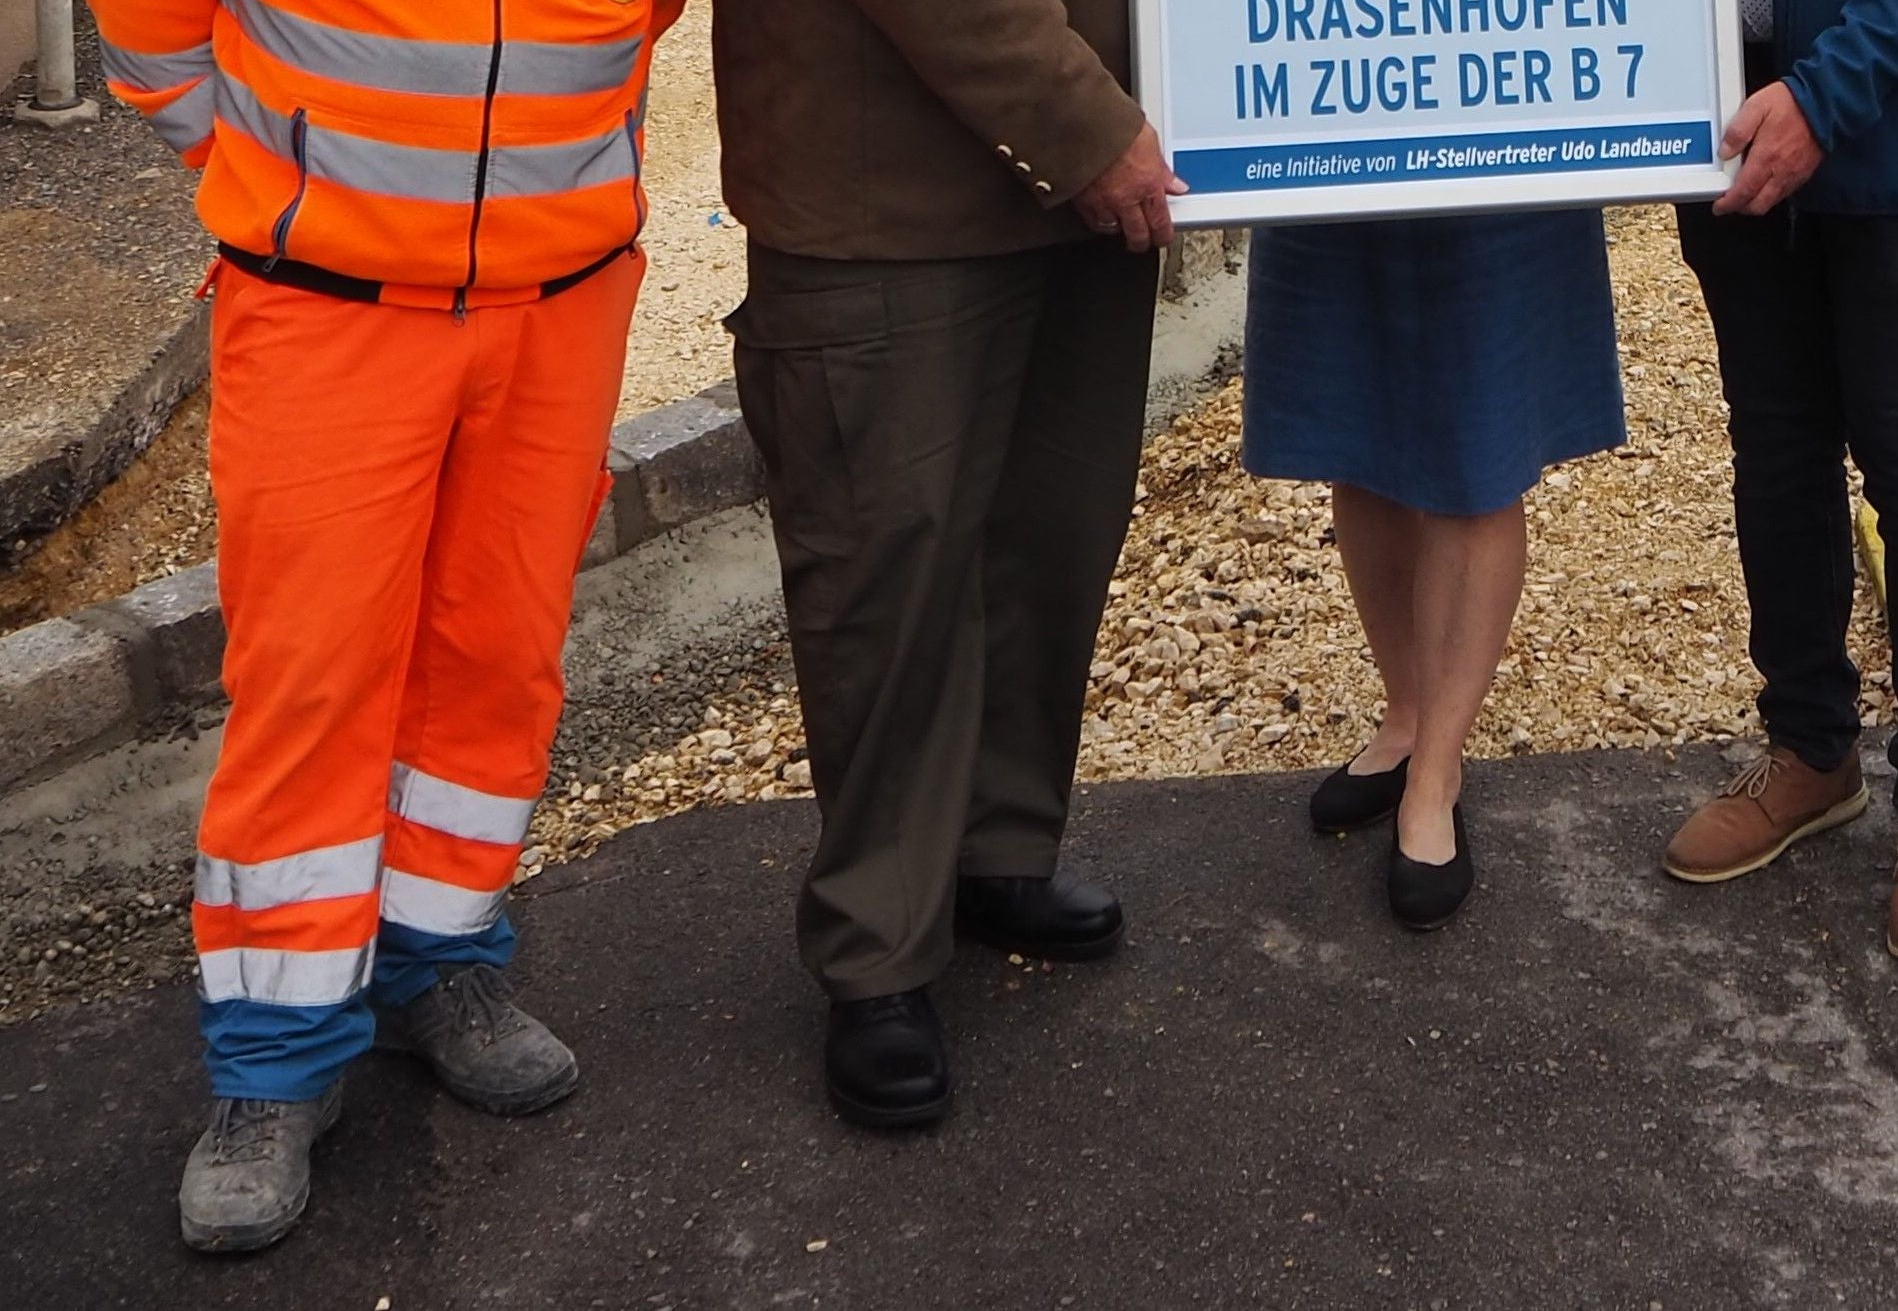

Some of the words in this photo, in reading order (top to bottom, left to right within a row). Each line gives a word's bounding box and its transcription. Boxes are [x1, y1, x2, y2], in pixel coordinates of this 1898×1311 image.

[1235, 63, 1290, 120] IM
[1310, 55, 1439, 116] ZUGE
[1459, 50, 1552, 108] DER
[1572, 47, 1601, 101] B
[1618, 45, 1645, 98] 7
[1246, 161, 1282, 179] eine
[1286, 155, 1361, 177] Initiative
[1366, 158, 1396, 174] von
[1406, 142, 1556, 171] LH-Stellvertreter
[1561, 141, 1594, 161] Udo
[1600, 137, 1691, 159] Landbauer
